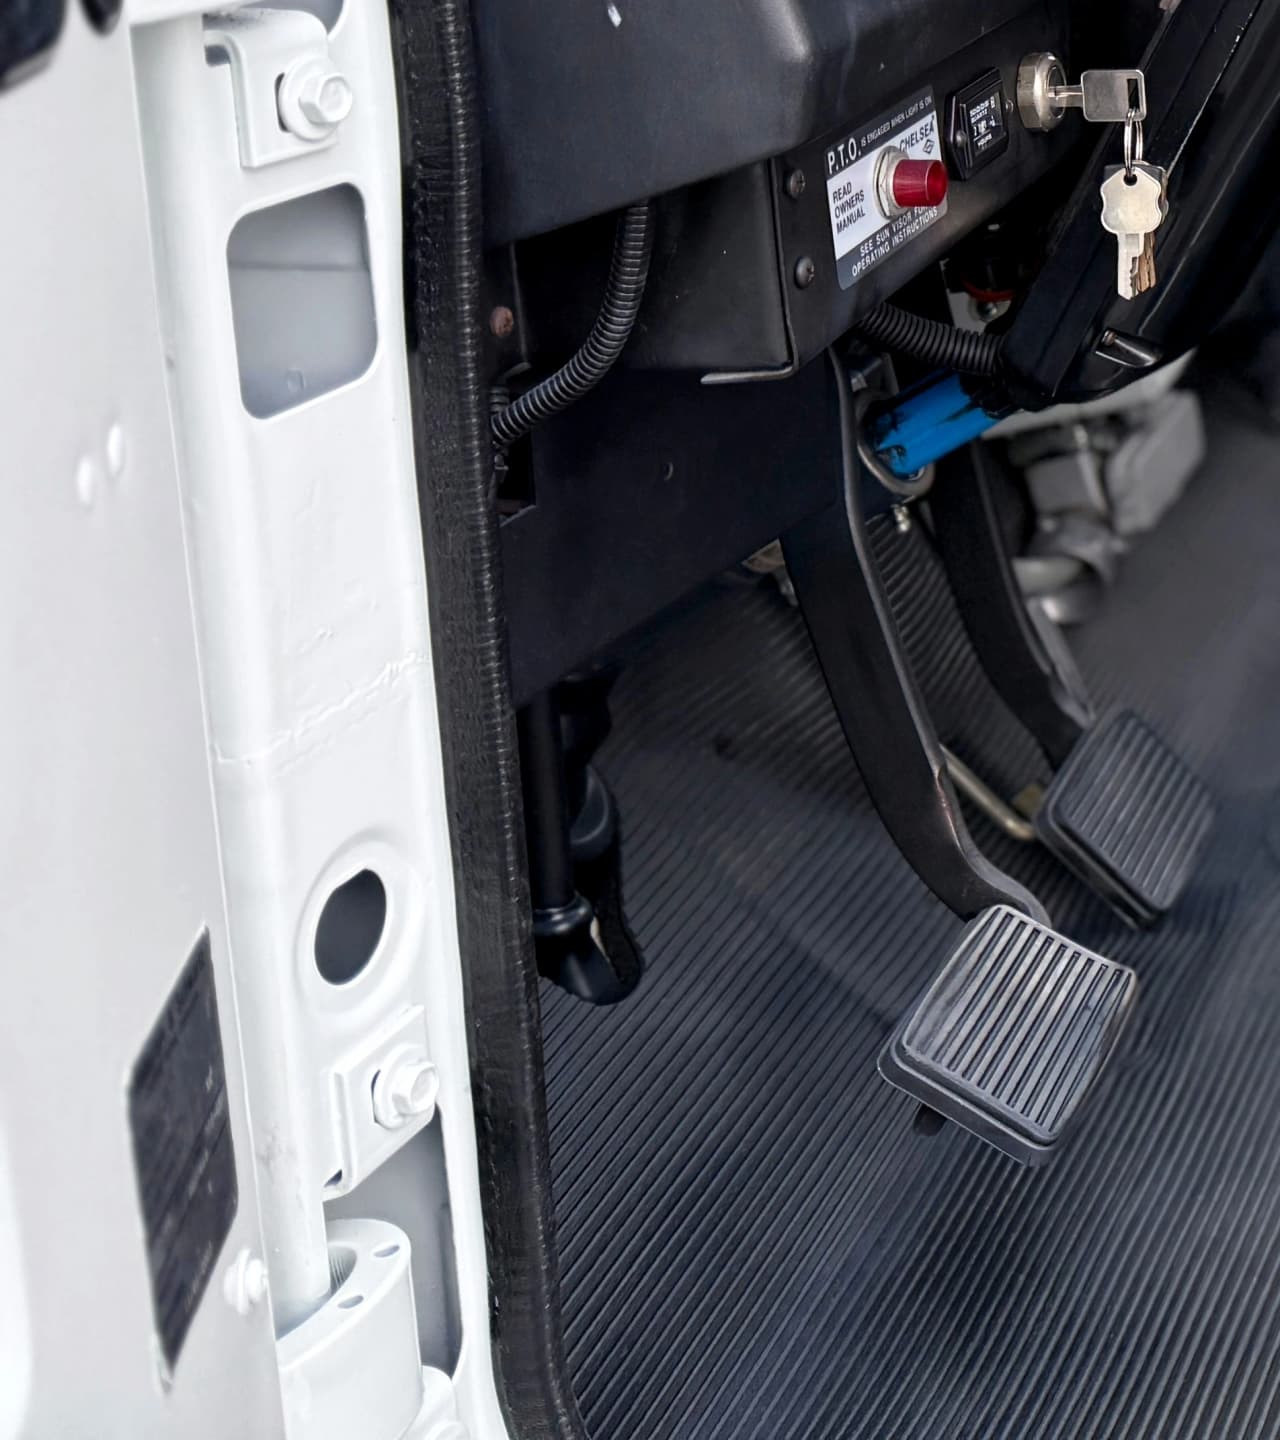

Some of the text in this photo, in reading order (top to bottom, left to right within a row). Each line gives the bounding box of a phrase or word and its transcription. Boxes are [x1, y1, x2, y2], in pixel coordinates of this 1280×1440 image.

[827, 137, 861, 175] P.T.O.
[866, 122, 891, 143] ENGAGED
[891, 113, 905, 128] WHEN
[905, 104, 919, 118] LIGHT
[924, 95, 932, 106] ON
[899, 120, 935, 152] CHELSEA
[832, 182, 852, 204] READ
[834, 190, 864, 218] OWNERS
[836, 207, 866, 234] MANUAL
[852, 207, 938, 277] OPERATING INSTRUCTIONS
[860, 240, 874, 257] SEE
[876, 227, 890, 244] SUN
